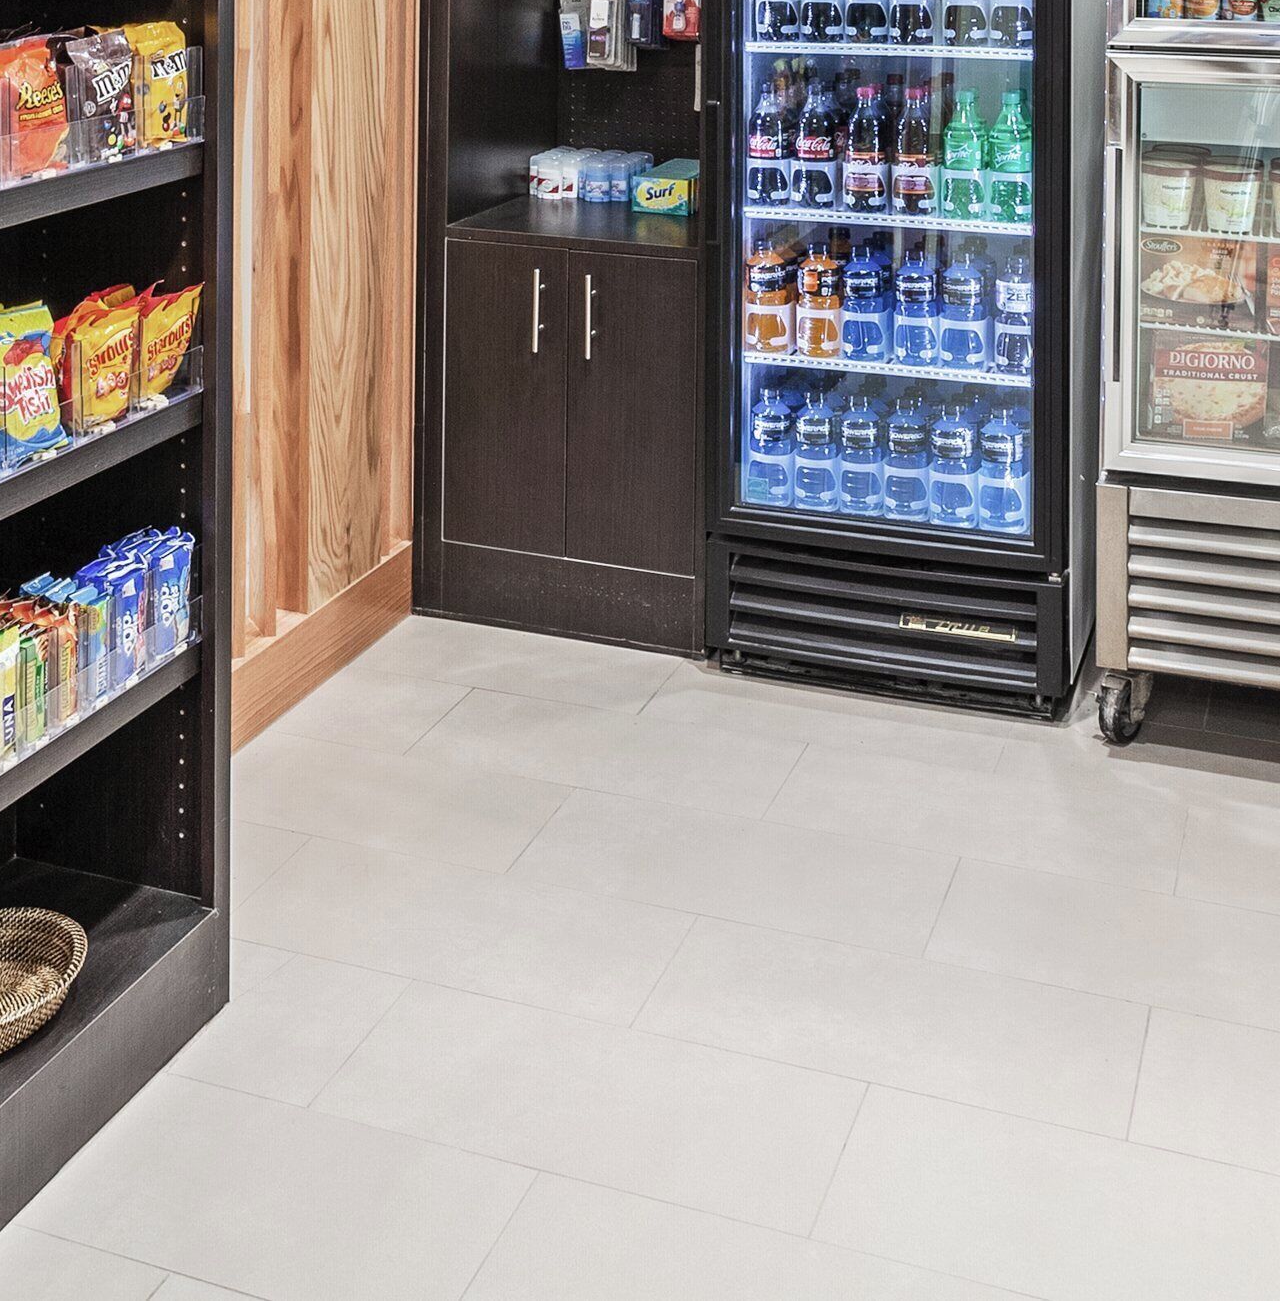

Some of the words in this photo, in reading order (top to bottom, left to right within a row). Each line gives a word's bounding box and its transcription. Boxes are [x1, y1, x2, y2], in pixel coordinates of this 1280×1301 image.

[646, 183, 675, 201] Surf
[1146, 241, 1177, 252] Stouffer's
[1170, 351, 1255, 369] DIGIORNO
[1163, 369, 1226, 379] TRADITIONAL
[1228, 373, 1258, 381] CRUST
[17, 389, 52, 424] Fish
